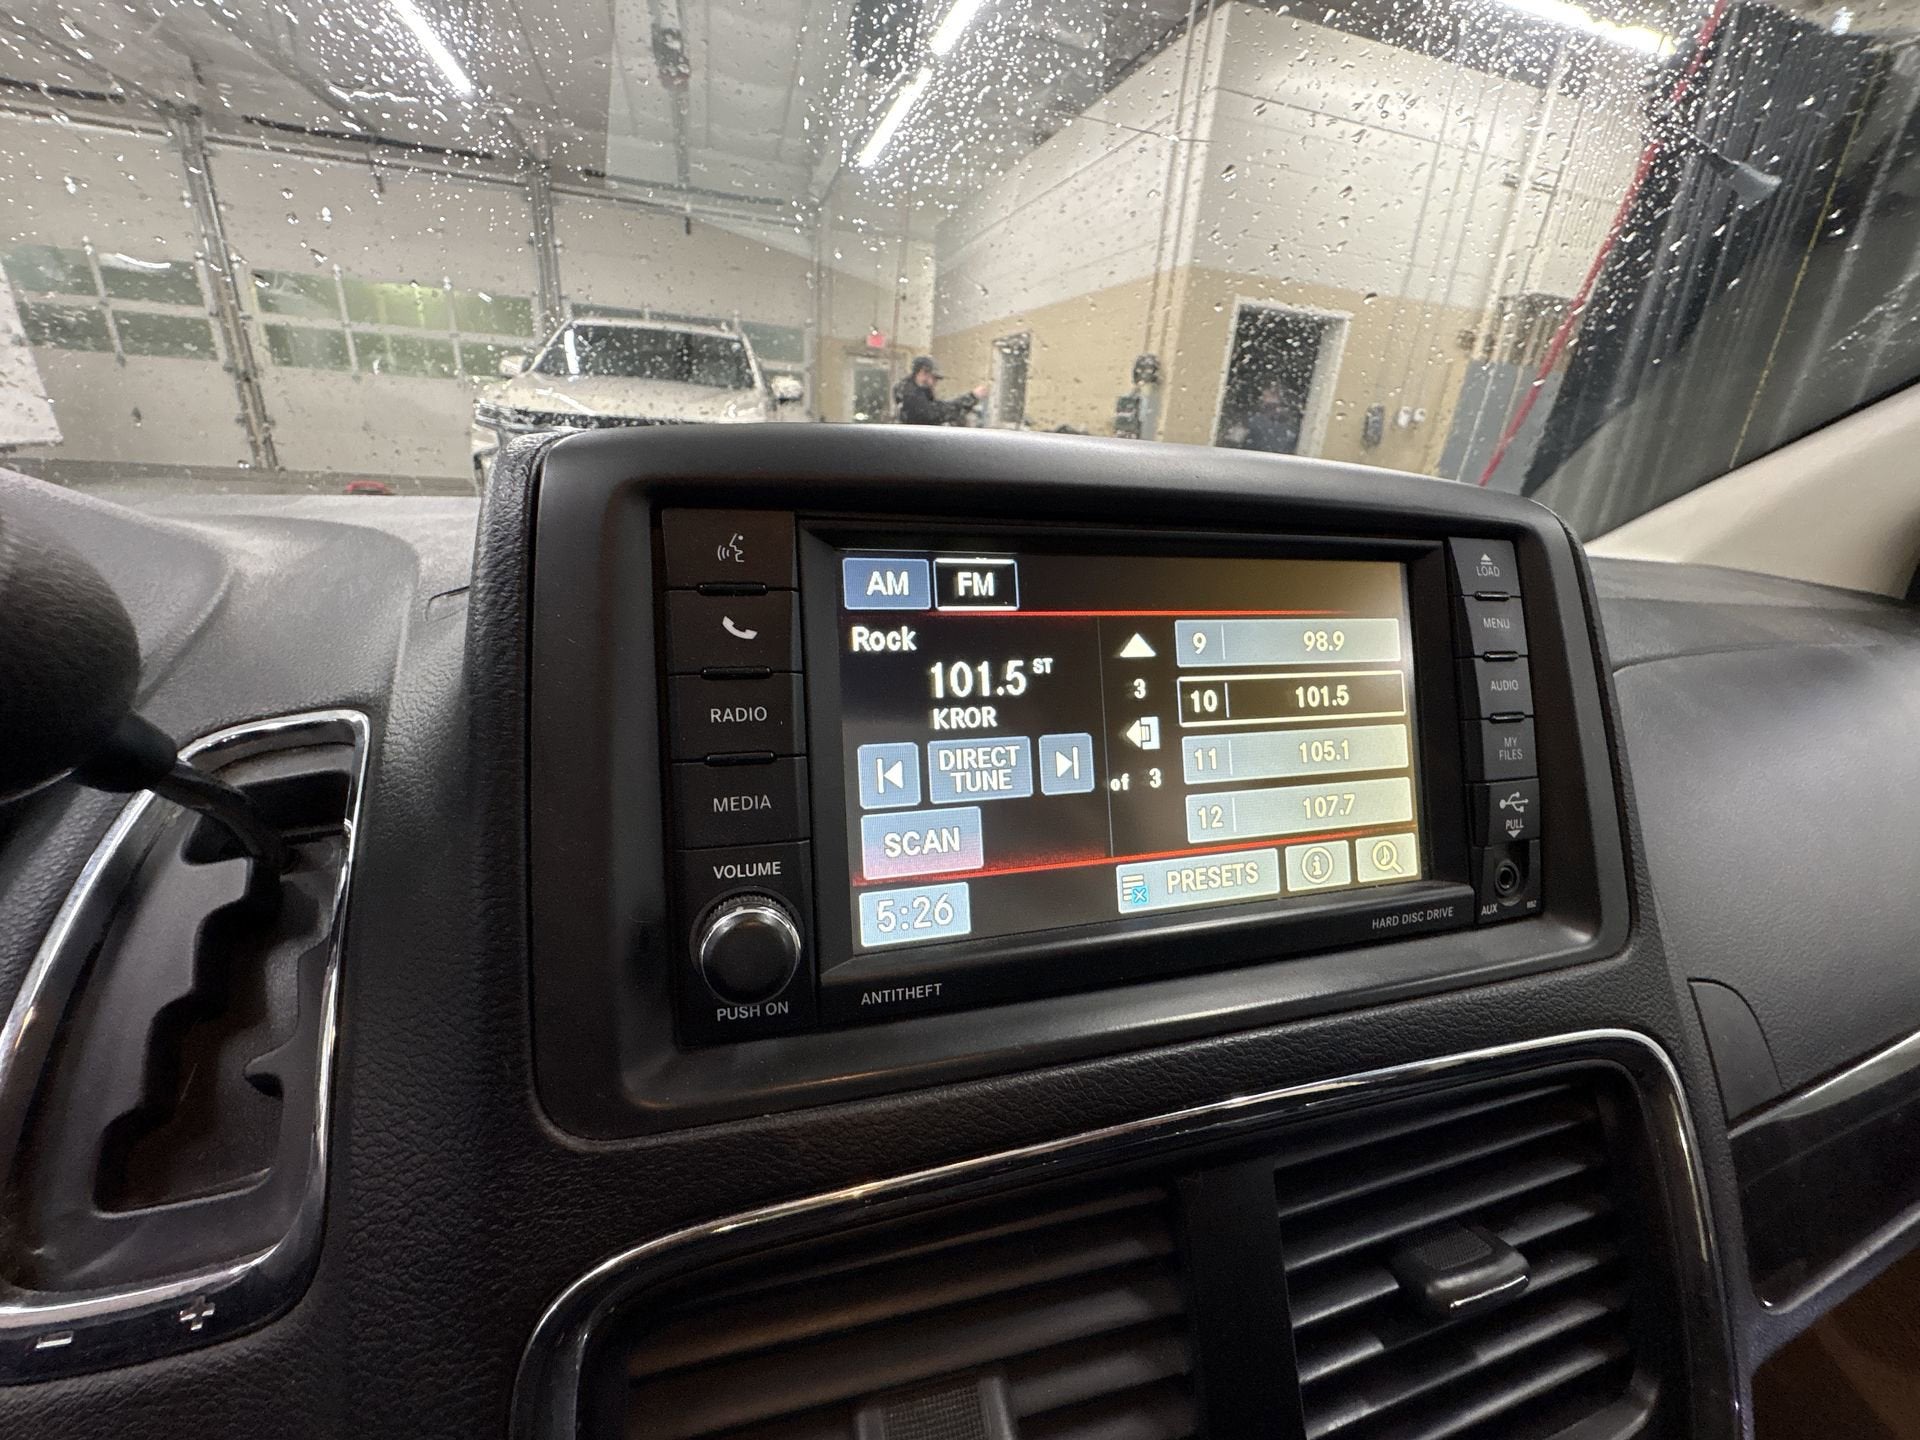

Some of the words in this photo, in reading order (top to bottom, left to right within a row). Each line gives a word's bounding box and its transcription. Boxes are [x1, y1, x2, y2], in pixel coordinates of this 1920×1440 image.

[1476, 566, 1500, 577] LOAD
[866, 571, 909, 596] AM
[957, 571, 995, 597] FM
[1483, 617, 1510, 629] MENU
[852, 626, 917, 652] Rock
[1192, 632, 1207, 654] 9
[1303, 630, 1345, 652] 98.9
[930, 660, 1027, 699] 101.5
[1032, 658, 1053, 674] ST
[1133, 679, 1146, 699] 3
[1490, 679, 1519, 691] AUDIO
[1191, 689, 1218, 713] 10
[1295, 684, 1349, 708] 101.5
[710, 706, 768, 723] RADIO
[933, 706, 998, 730] KROR
[1299, 740, 1350, 763] 105.1
[1504, 737, 1517, 748] MY
[939, 745, 1020, 772] DIRECT
[1194, 747, 1218, 771] 11
[1499, 749, 1523, 760] FILES
[950, 769, 1012, 793] TUNE
[1110, 773, 1130, 791] of
[1149, 768, 1161, 788] 3
[713, 795, 772, 812] MEDIA
[1303, 794, 1355, 819] 107.7
[1198, 805, 1224, 829] 12
[1505, 818, 1524, 830] PULL
[884, 827, 961, 858] SCAN
[713, 861, 782, 879] VOLUME
[1166, 861, 1259, 894] PRESETS
[876, 893, 954, 933] 5:26
[1372, 915, 1399, 930] HARD
[1402, 911, 1425, 925] DISC
[1427, 906, 1454, 920] DRIVE
[1481, 903, 1498, 916] AUX
[861, 983, 943, 1005] ANTITHEFT
[716, 1005, 760, 1021] PUSH
[765, 1001, 789, 1016] ON
